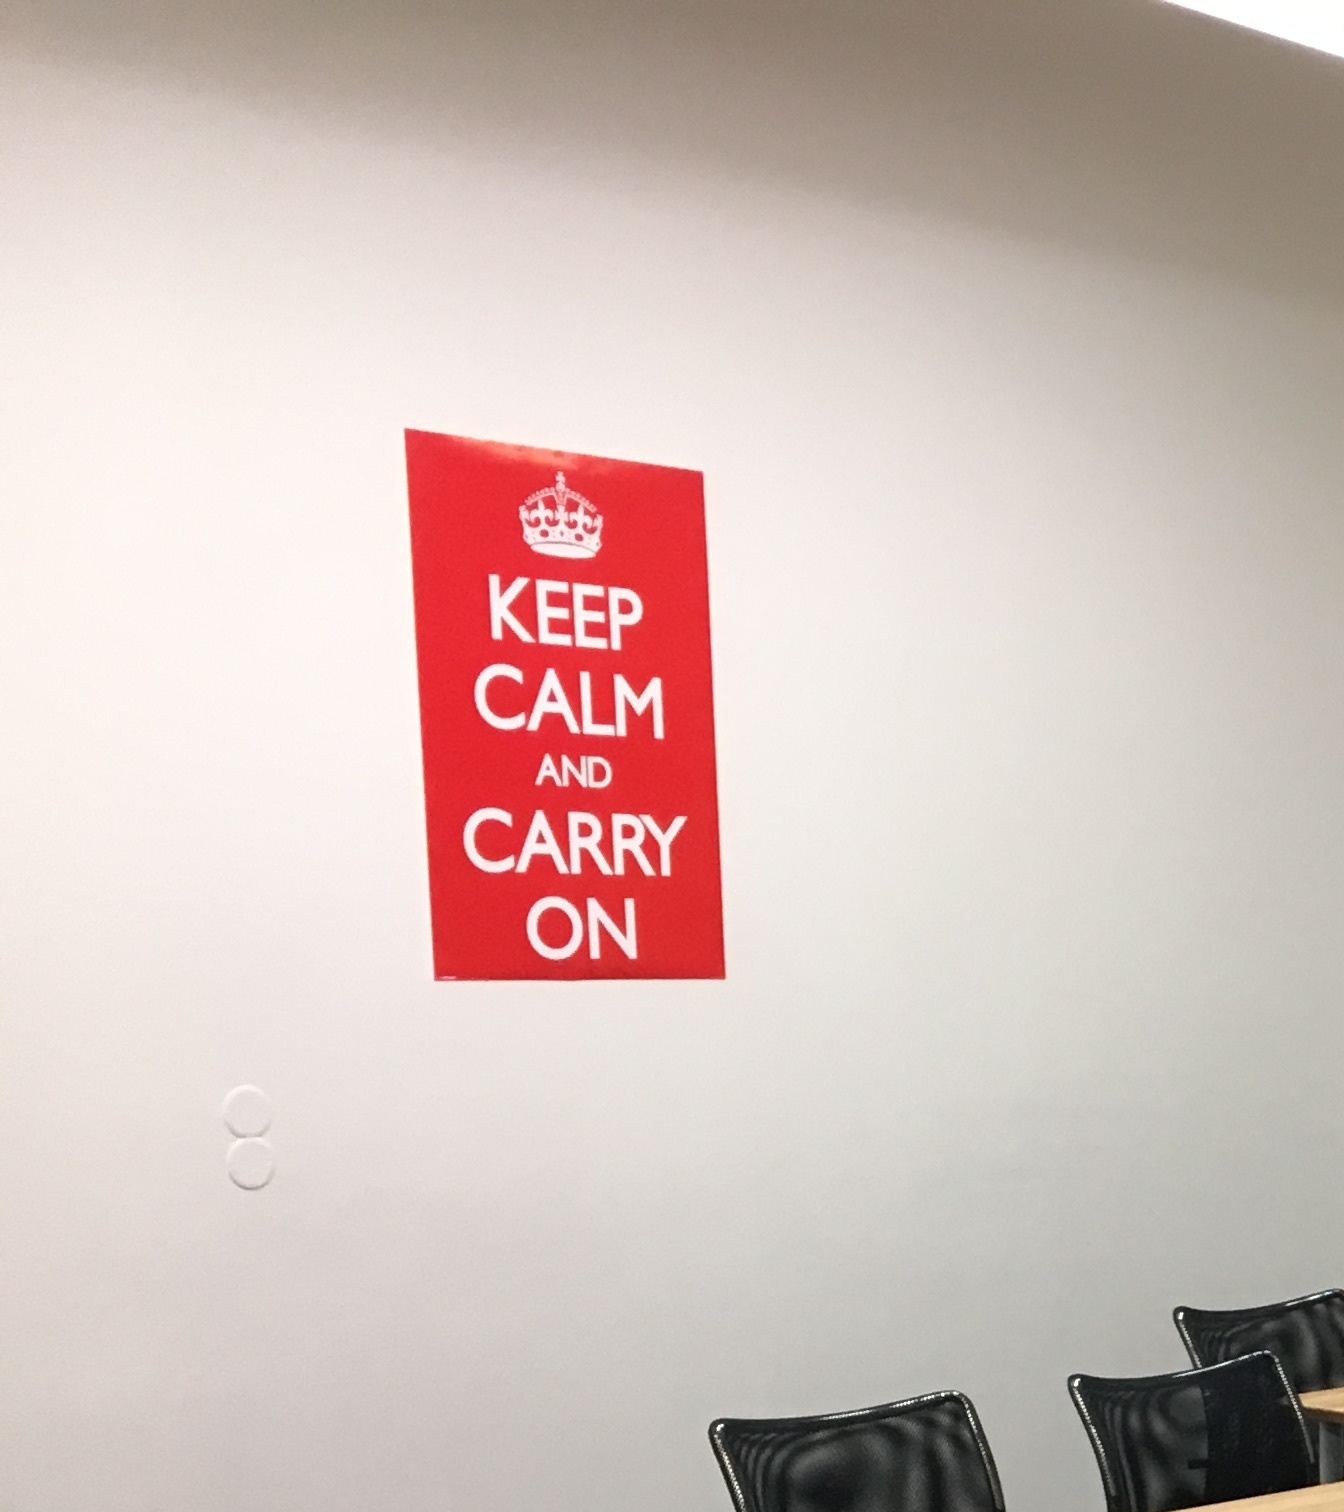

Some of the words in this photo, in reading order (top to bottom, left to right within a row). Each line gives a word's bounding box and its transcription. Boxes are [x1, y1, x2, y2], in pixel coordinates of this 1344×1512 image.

[488, 574, 643, 650] KEEP
[475, 664, 664, 740] CALM
[535, 754, 612, 789] AND
[463, 808, 687, 877] CARRY
[526, 896, 638, 960] ON
